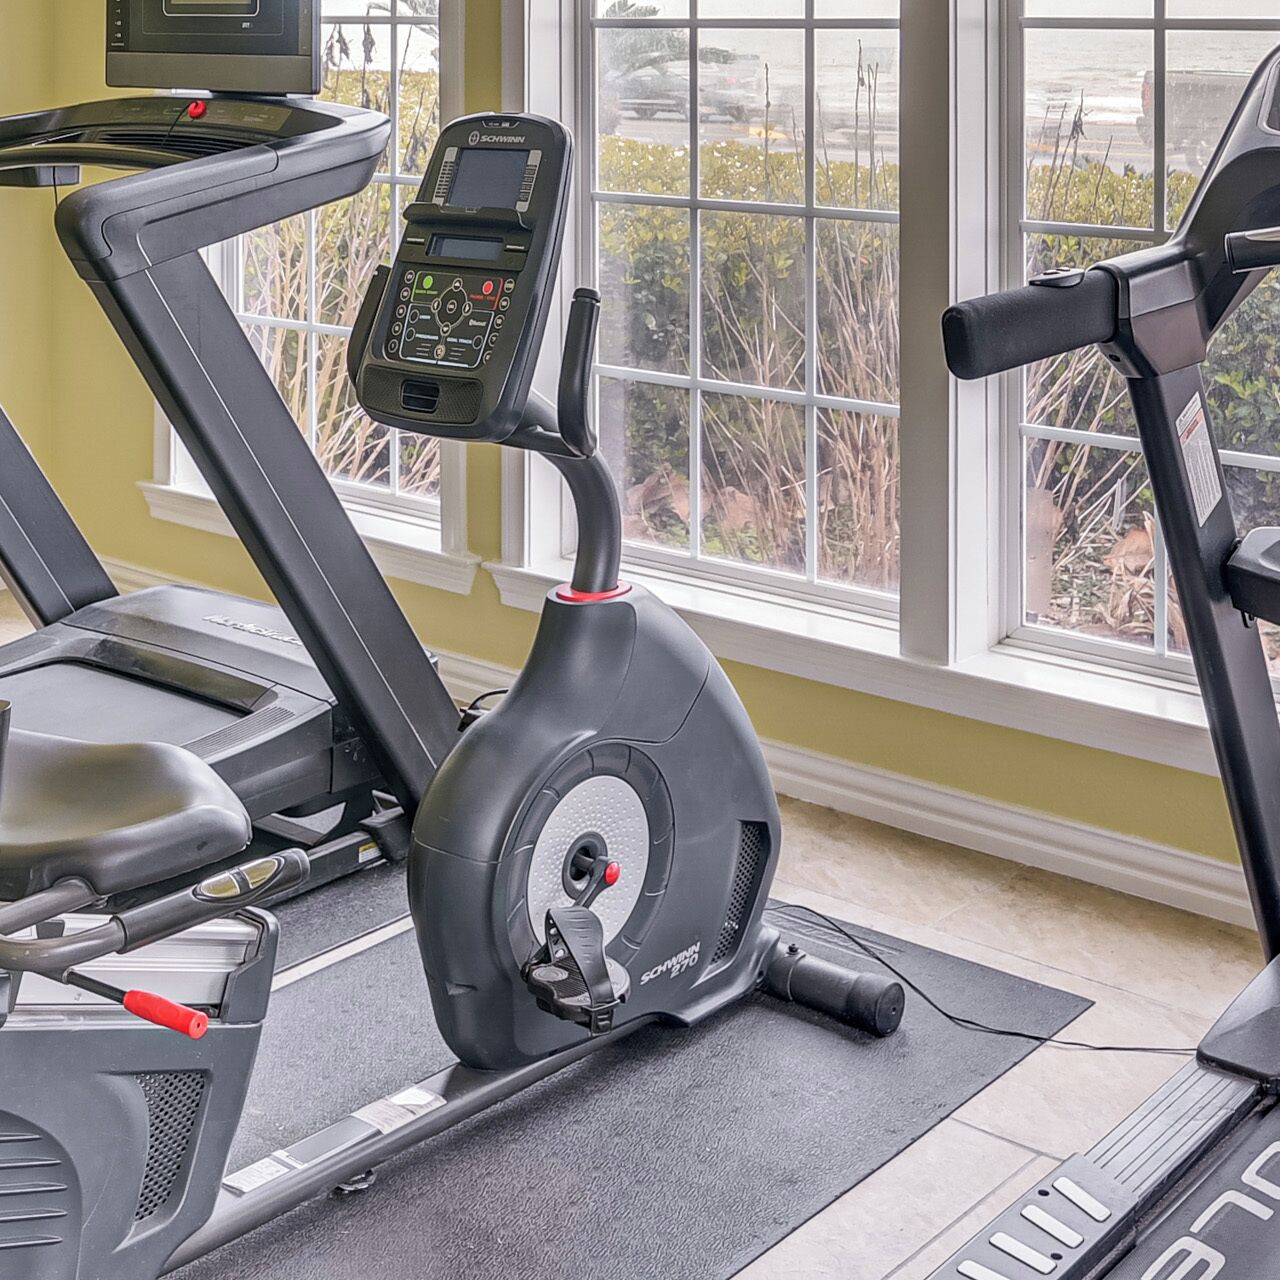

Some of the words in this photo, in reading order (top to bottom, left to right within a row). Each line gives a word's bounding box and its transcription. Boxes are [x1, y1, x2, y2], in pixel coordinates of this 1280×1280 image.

[480, 134, 526, 144] SCHWINN
[640, 941, 701, 985] SCHWINN
[670, 952, 699, 979] 270
